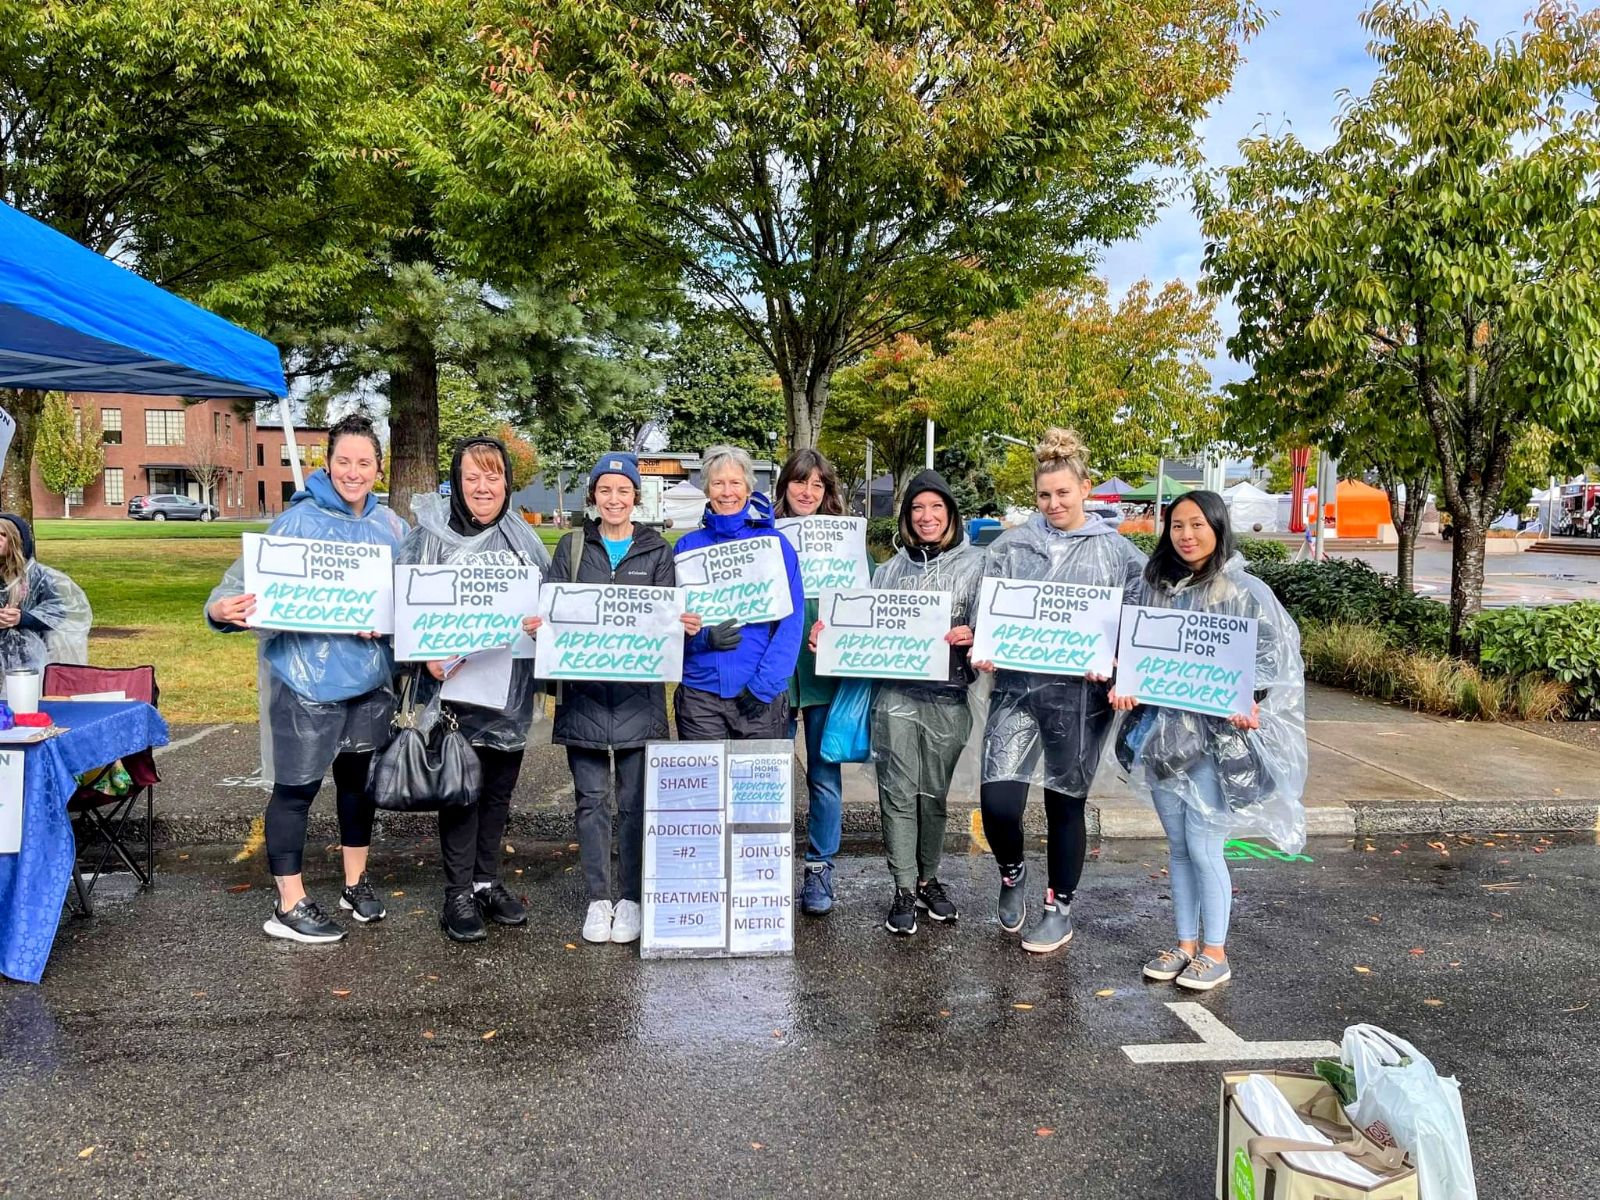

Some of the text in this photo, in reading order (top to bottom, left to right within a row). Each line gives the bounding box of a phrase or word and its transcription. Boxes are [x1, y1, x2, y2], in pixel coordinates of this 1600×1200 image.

[804, 520, 857, 530] OREGON
[804, 531, 844, 541] MOMS
[310, 543, 380, 558] OREGON
[708, 538, 772, 558] OREGON
[805, 542, 832, 552] FOR
[311, 555, 360, 569] MOMS
[710, 553, 754, 571] MOMS
[800, 558, 857, 572] ICTION
[311, 569, 344, 580] FOR
[460, 568, 528, 580] OREGON
[712, 568, 742, 583] FOR
[802, 574, 856, 588] OVERY
[264, 582, 378, 604] ADDICTION
[460, 582, 508, 592] MOMS
[688, 579, 774, 604] DDICTION
[1042, 584, 1112, 600] OREGON
[460, 595, 492, 606] FOR
[604, 588, 674, 601] OREGON
[877, 594, 940, 606] OREGON
[603, 602, 653, 614] MOMS
[686, 597, 773, 616] ECOVERY
[1040, 597, 1089, 612] MOMS
[270, 602, 375, 624] RECOVERY
[876, 607, 920, 618] MOMS
[1039, 610, 1072, 623] FOR
[412, 612, 524, 630] ADDICTION
[602, 615, 636, 626] FOR
[876, 618, 906, 630] FOR
[1187, 614, 1248, 632] OREGON
[418, 632, 521, 650] RECOVERY
[554, 632, 668, 650] ADDICTION
[835, 634, 935, 650] ADDICTION
[992, 624, 1102, 648] ADDICTION
[1186, 628, 1230, 644] MOMS
[994, 642, 1096, 667] RECOVERY
[1184, 643, 1216, 657] FOR
[559, 651, 664, 673] RECOVERY
[838, 651, 931, 671] RECOVERY
[1136, 656, 1242, 686] ADDICTION
[1140, 676, 1238, 707] RECOVERY
[650, 755, 718, 768] OREGON'S
[754, 758, 789, 766] OREGON
[660, 778, 708, 790] SHAME
[732, 782, 786, 791] ADDICTION
[734, 792, 784, 800] RECOVERY
[647, 824, 722, 836] ADDICTION
[739, 846, 791, 858] JOIN US
[756, 868, 774, 880] TO
[645, 892, 728, 904] TREATMENT
[732, 896, 790, 908] FLIP THIS
[734, 918, 785, 930] METRIC
